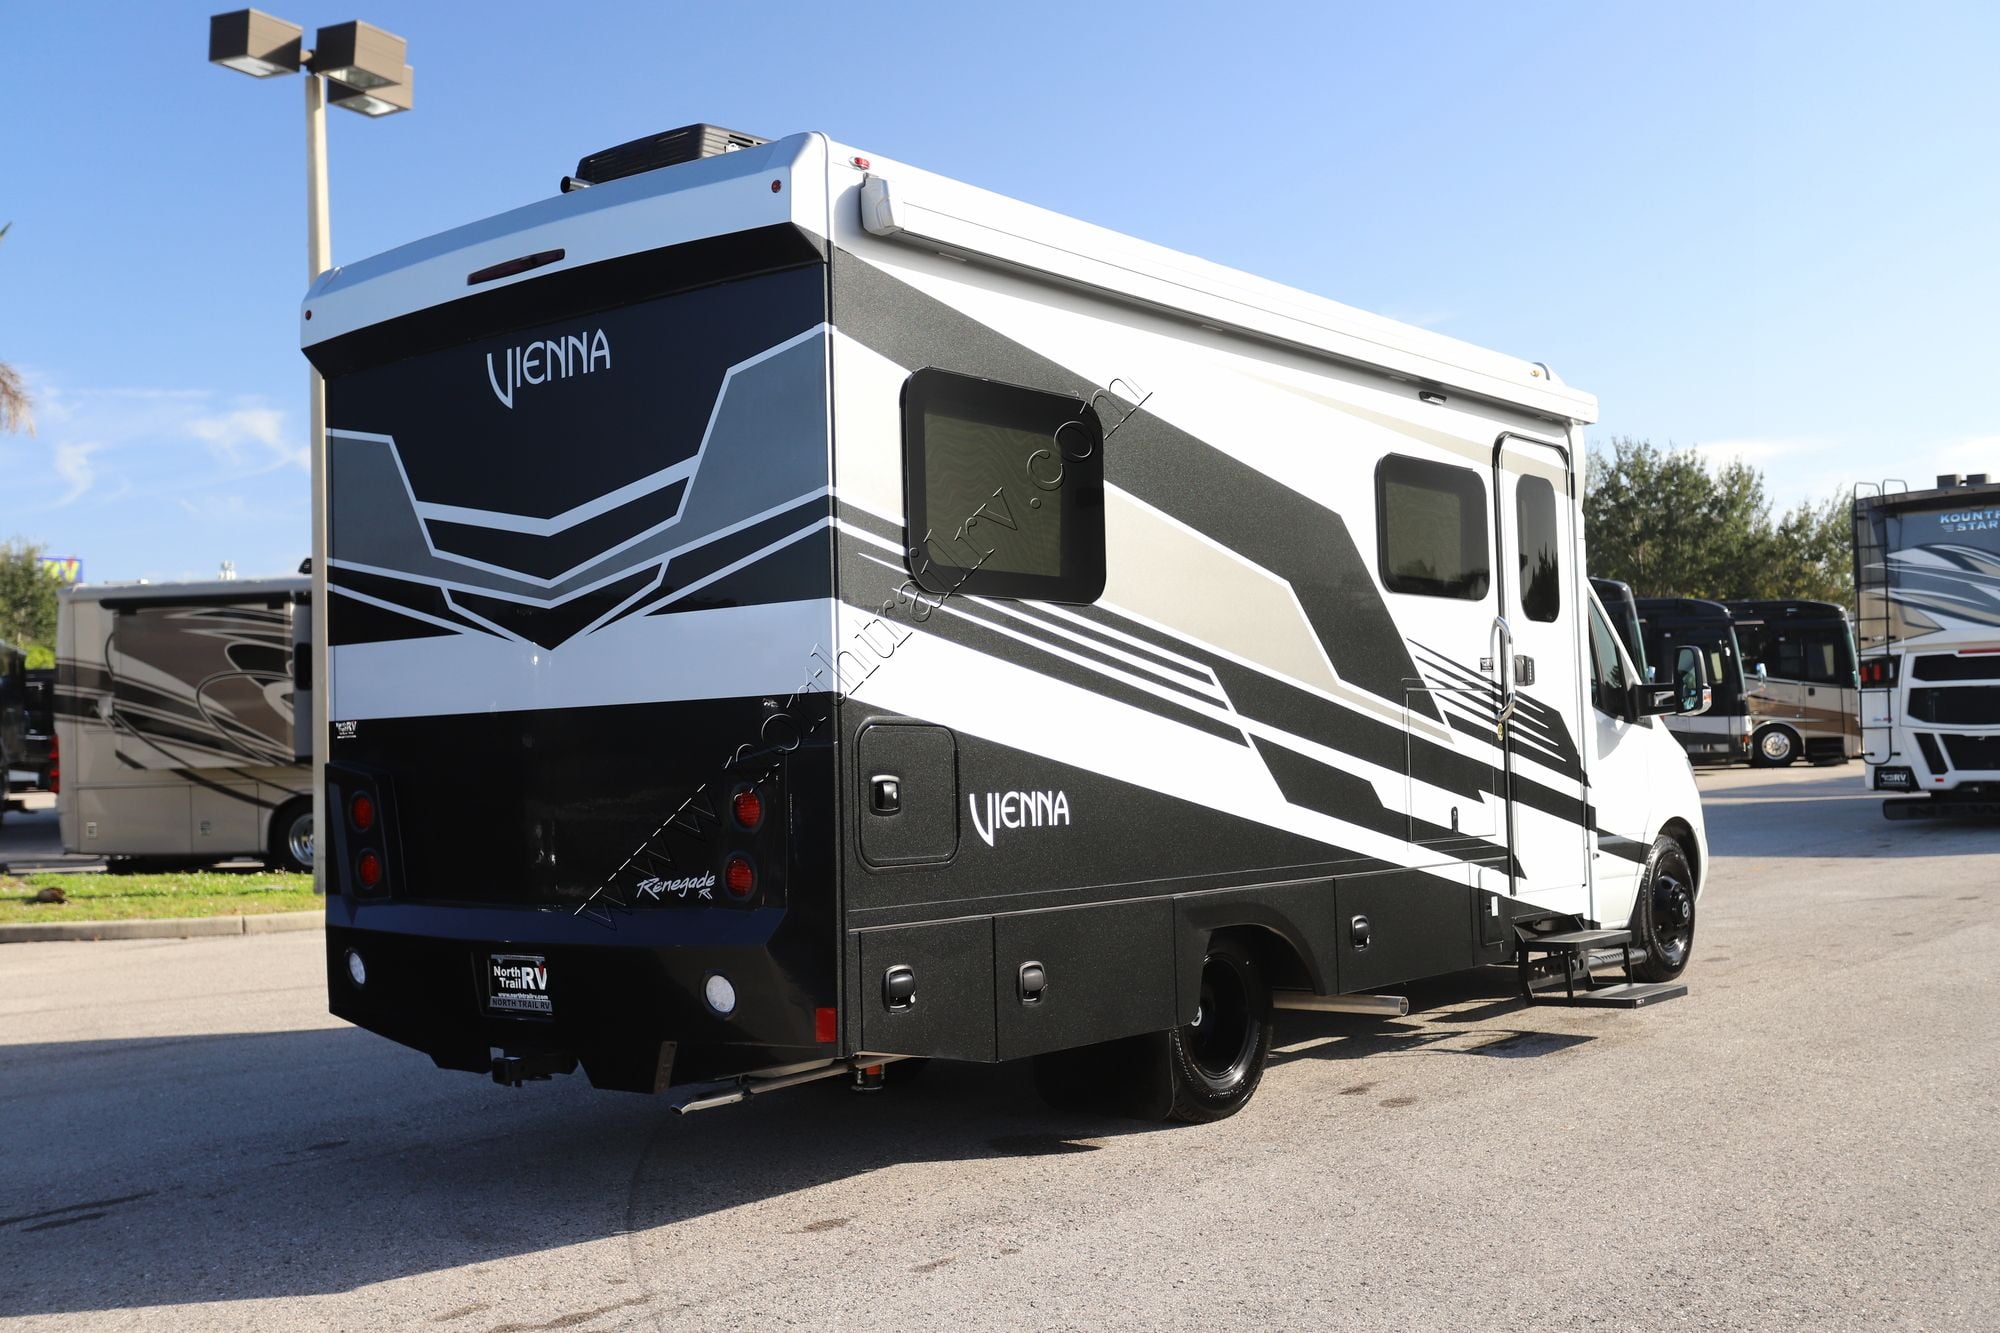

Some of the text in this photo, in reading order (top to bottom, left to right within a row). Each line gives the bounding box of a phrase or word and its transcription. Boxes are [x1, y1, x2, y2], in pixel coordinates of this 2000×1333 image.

[487, 328, 611, 409] VIENNA
[1955, 520, 1999, 531] STAR
[969, 790, 1070, 847] VIENNA
[636, 870, 716, 900] Renegade
[493, 965, 521, 977] North
[521, 965, 548, 990] RV
[499, 977, 521, 989] Trail
[492, 999, 550, 1010] NORTH TRAIL RV
